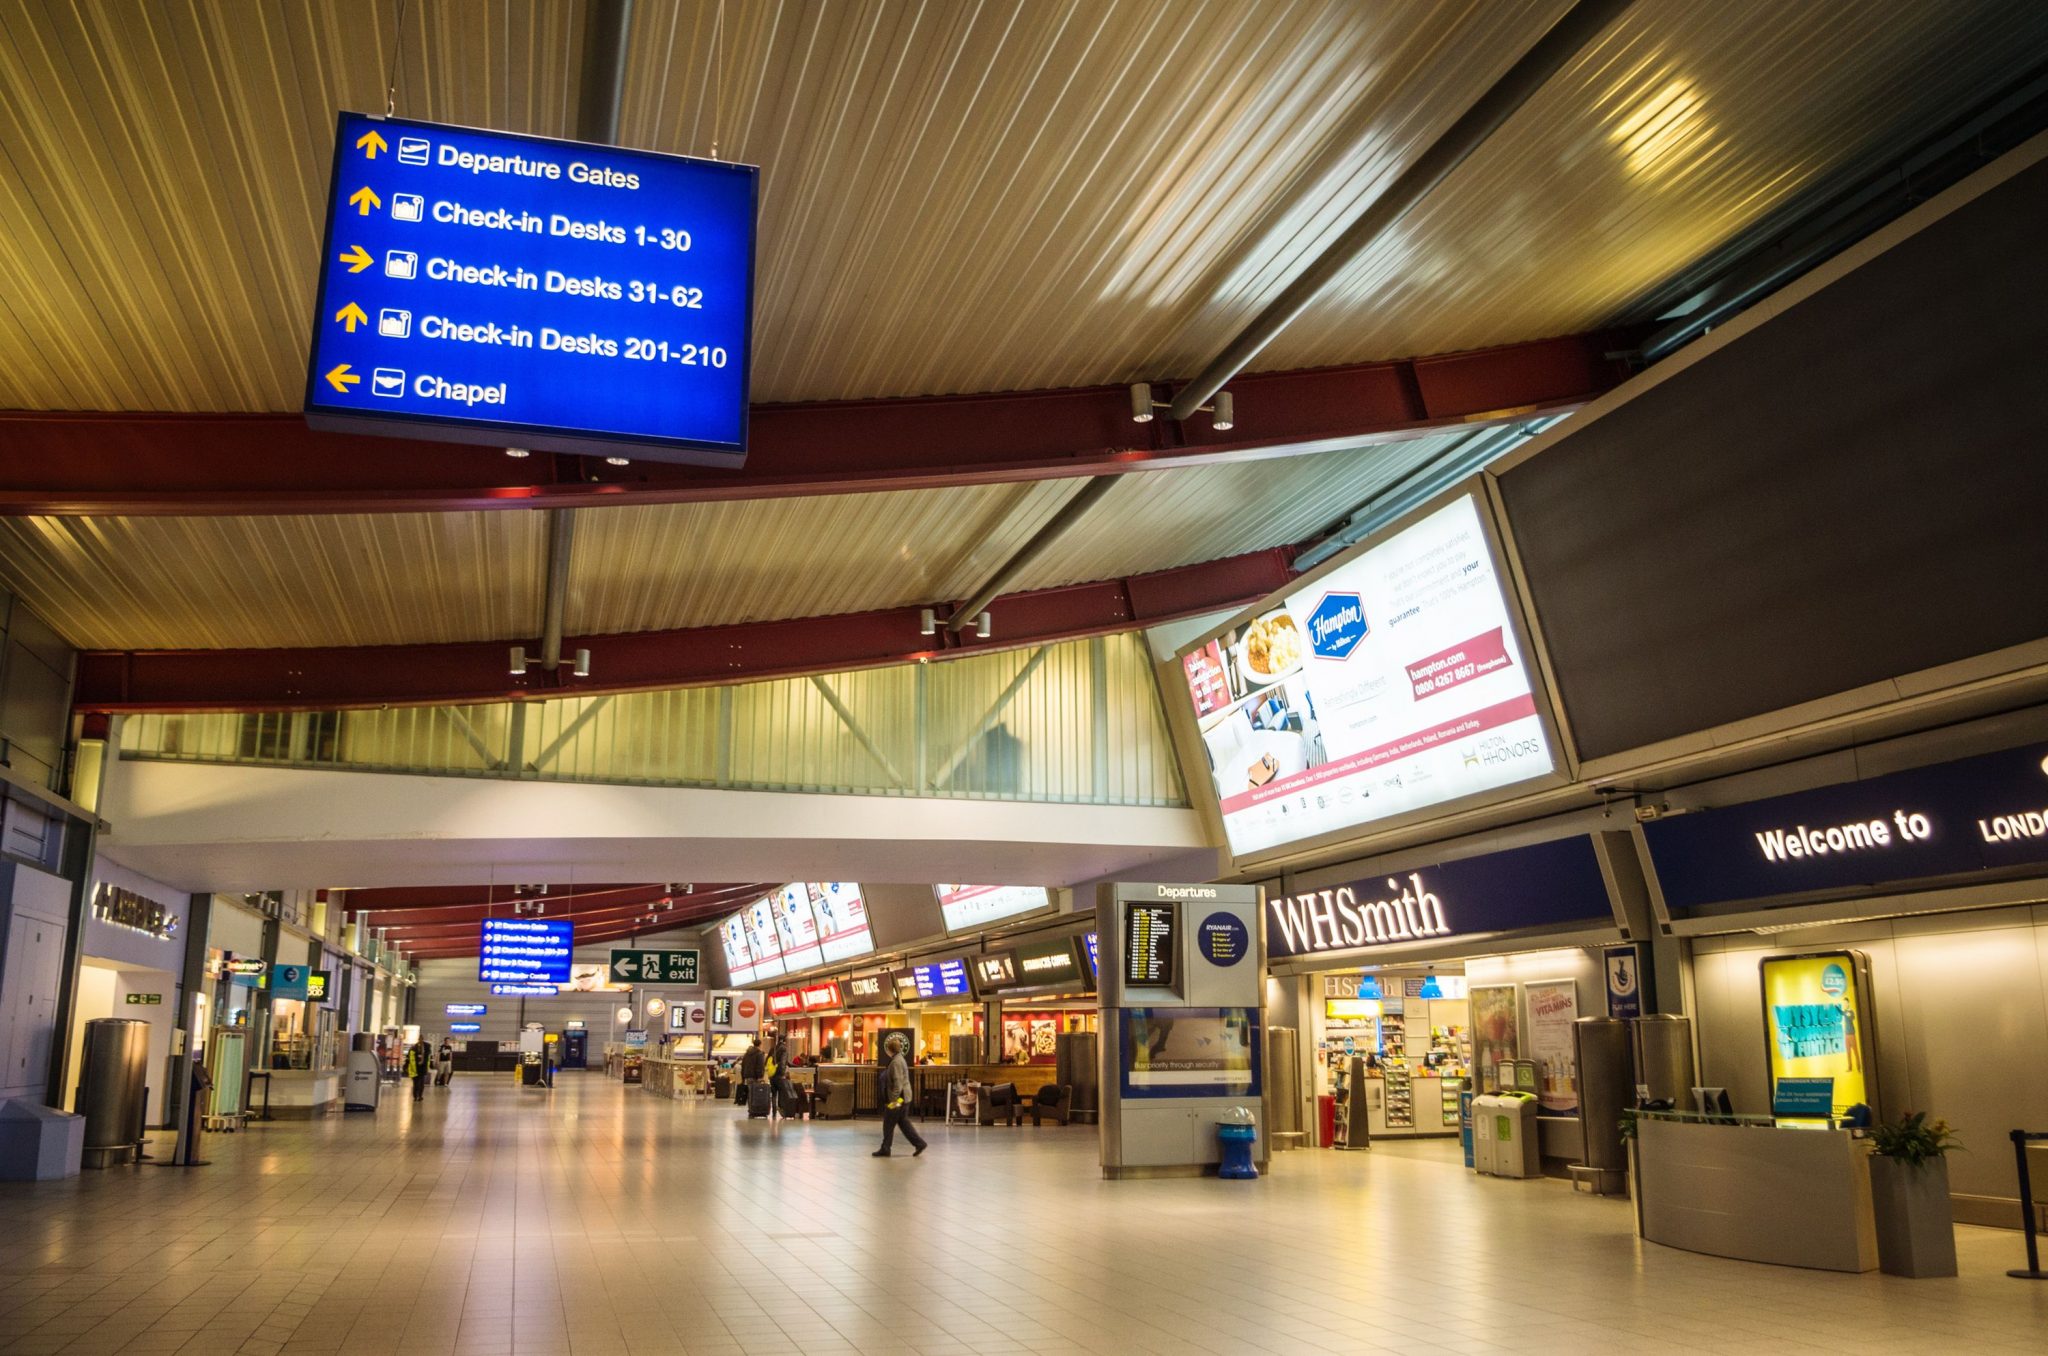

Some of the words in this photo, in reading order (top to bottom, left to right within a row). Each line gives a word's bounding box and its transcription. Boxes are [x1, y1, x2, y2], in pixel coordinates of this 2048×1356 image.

[438, 143, 562, 181] Departure
[568, 161, 641, 191] Gates
[432, 199, 543, 234] Check-in
[550, 215, 627, 244] Desks
[634, 227, 692, 252] 1-30
[426, 257, 538, 292] Check-in
[544, 272, 622, 301] Desks
[628, 283, 703, 309] 31-62
[419, 314, 533, 348] Check-in
[539, 329, 618, 358] Desks
[624, 338, 727, 369] 201-210
[413, 374, 507, 406] Chapel
[1462, 560, 1479, 576] your
[1311, 604, 1363, 646] Hampton
[1388, 606, 1420, 628] guarantee
[1410, 651, 1466, 681] hampton.com
[1415, 682, 1435, 696] 0800
[1435, 672, 1454, 688] 4267
[1455, 662, 1475, 680] 8667
[1479, 735, 1506, 750] HILTON
[1483, 738, 1540, 766] HHONORS
[1756, 817, 1889, 862] Welcome
[1894, 809, 1930, 841] to
[1157, 884, 1217, 898] Departures
[1271, 872, 1452, 954] WHSmith
[669, 955, 695, 967] Fire
[669, 968, 695, 981] exit
[1535, 997, 1573, 1017] VITAMINS
[1147, 1061, 1168, 1070] priority
[1169, 1061, 1195, 1069] through
[1195, 1061, 1218, 1069] security
